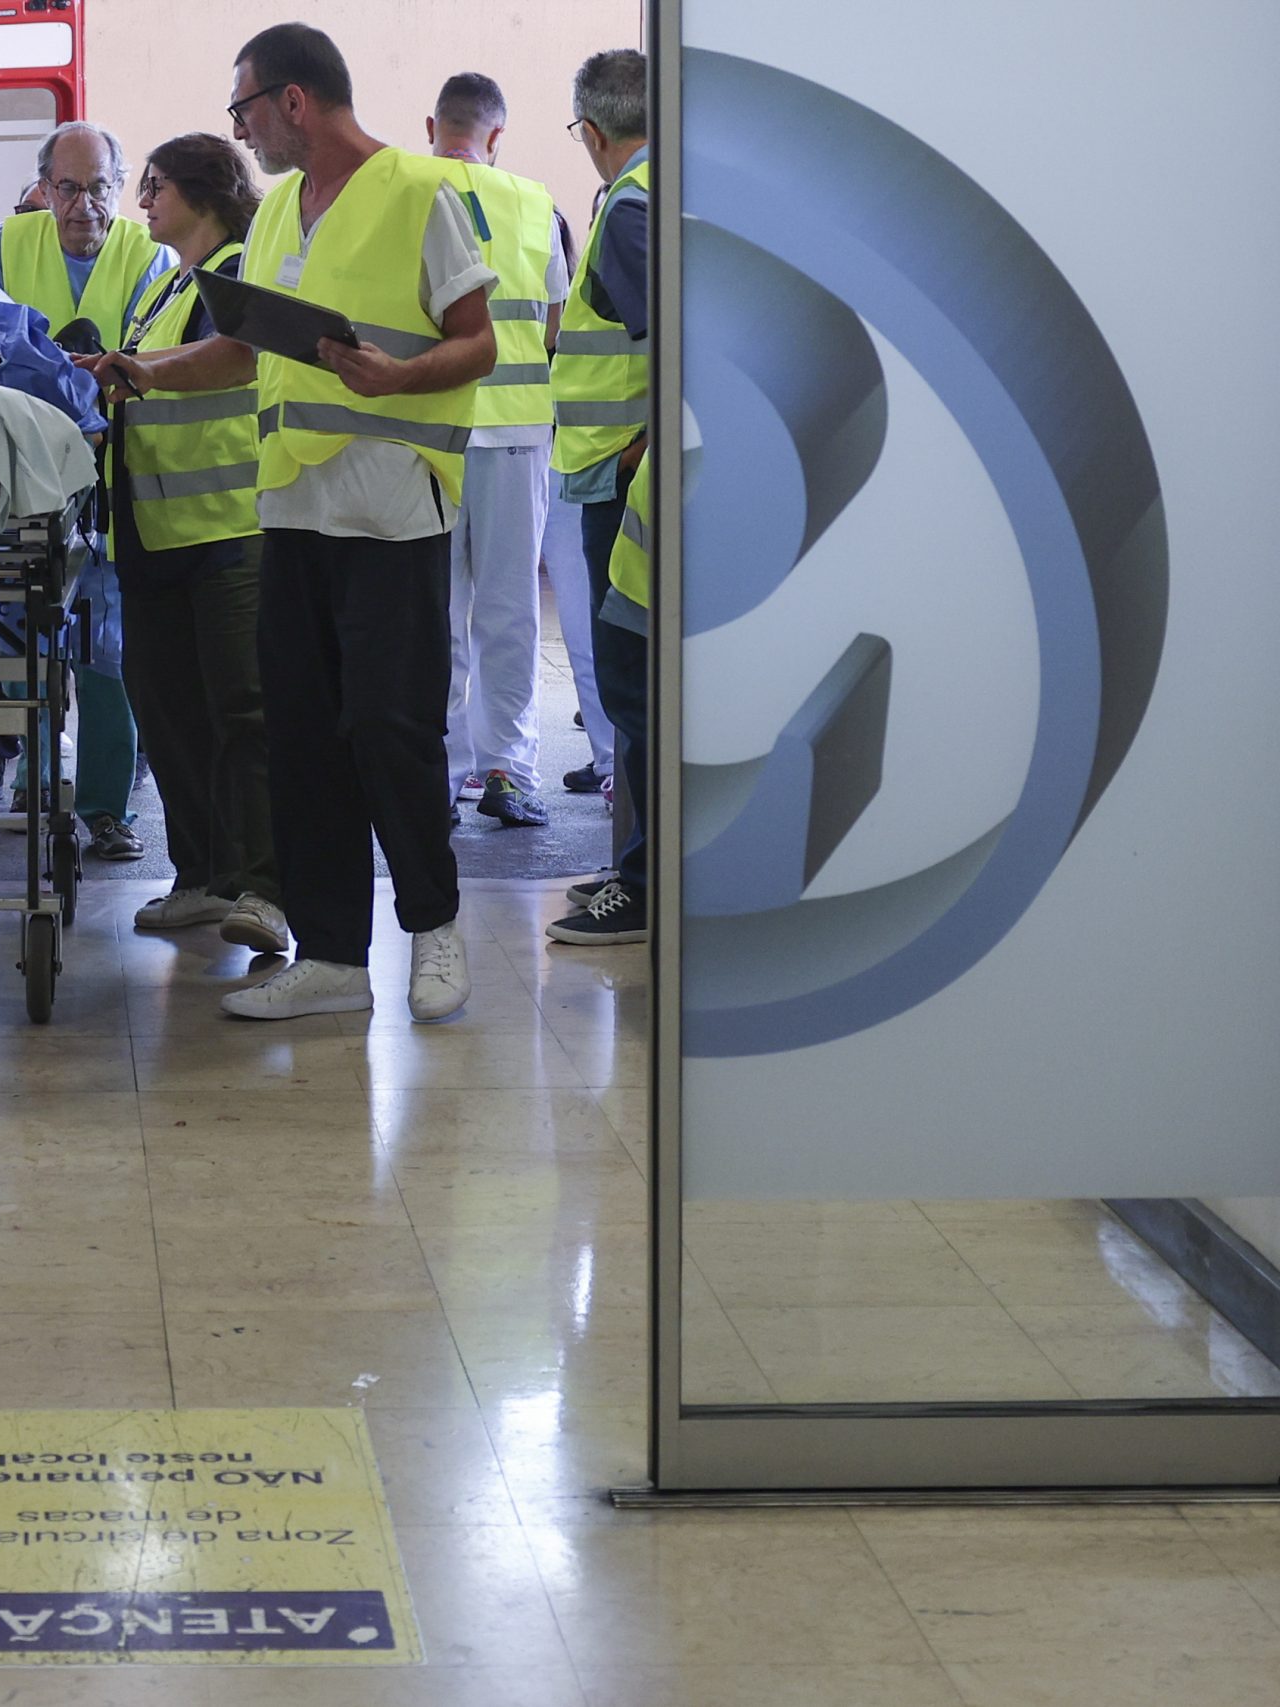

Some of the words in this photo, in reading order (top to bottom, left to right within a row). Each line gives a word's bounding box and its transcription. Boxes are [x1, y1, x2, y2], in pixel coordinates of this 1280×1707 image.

[126, 1453, 253, 1465] neste
[213, 1471, 324, 1488] NÃO
[17, 1510, 168, 1522] macas
[186, 1510, 242, 1524] de
[163, 1531, 218, 1544] de
[236, 1530, 356, 1545] Zona
